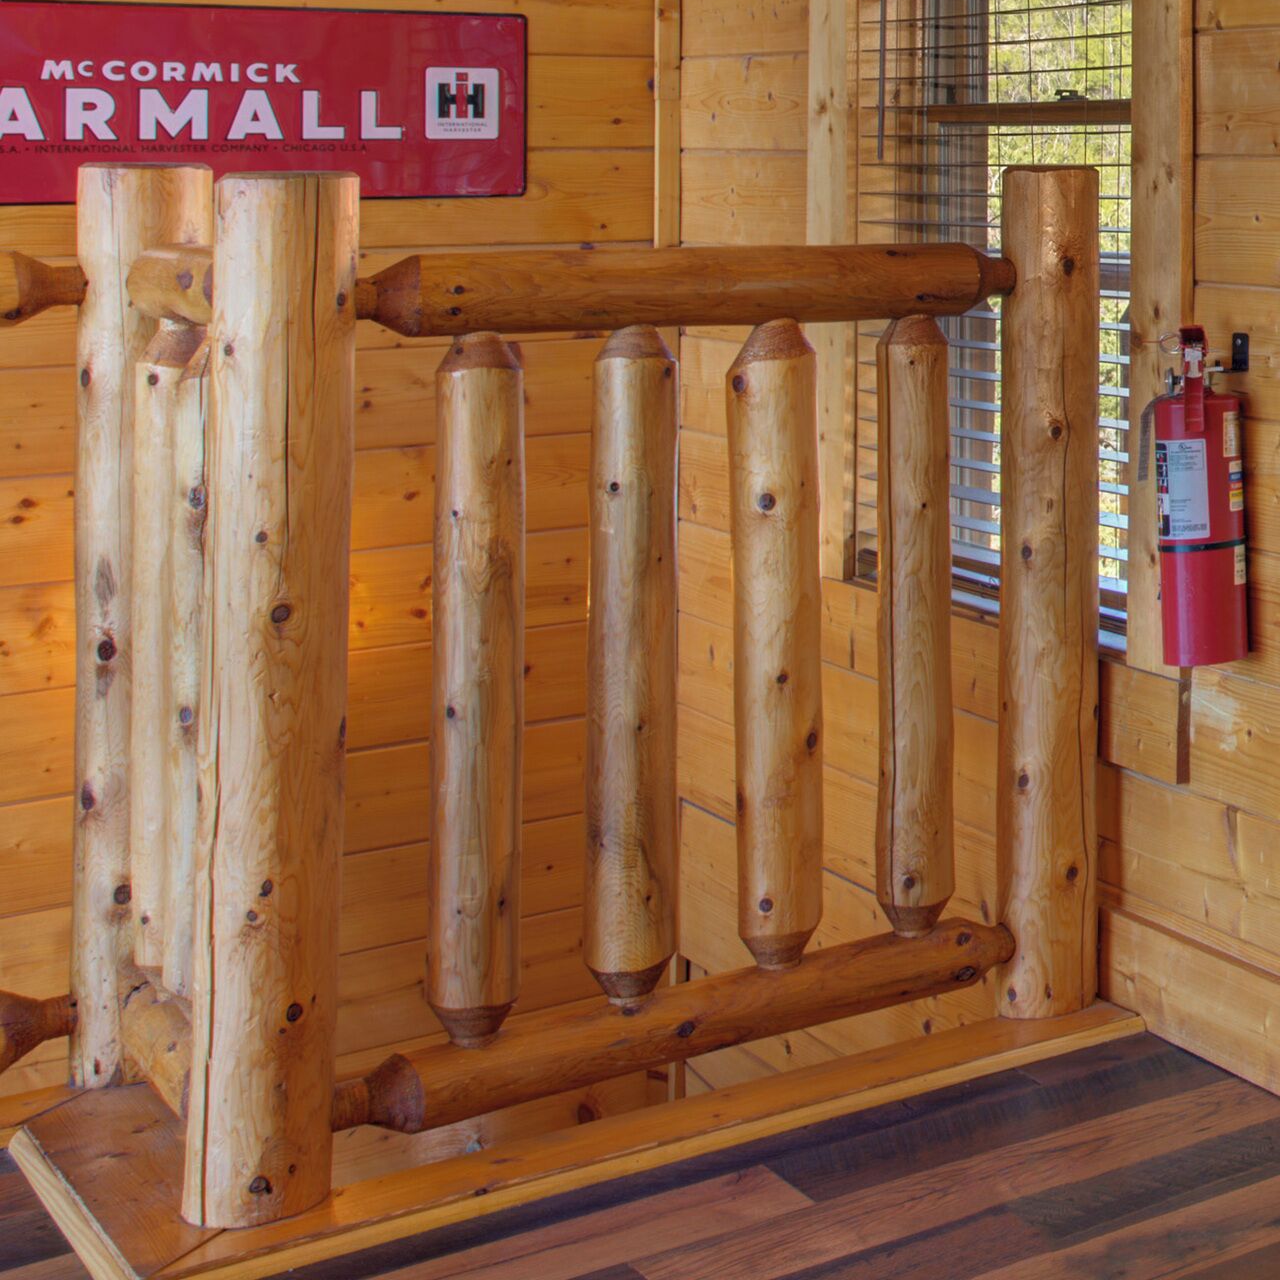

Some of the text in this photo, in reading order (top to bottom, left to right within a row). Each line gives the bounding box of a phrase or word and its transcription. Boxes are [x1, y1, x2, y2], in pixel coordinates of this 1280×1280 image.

[0, 87, 402, 141] ARMALL
[35, 144, 136, 154] INTERNATIONAL
[141, 144, 206, 153] HARVESTER
[211, 144, 269, 153] COMPANY
[282, 143, 335, 153] CHICAGO
